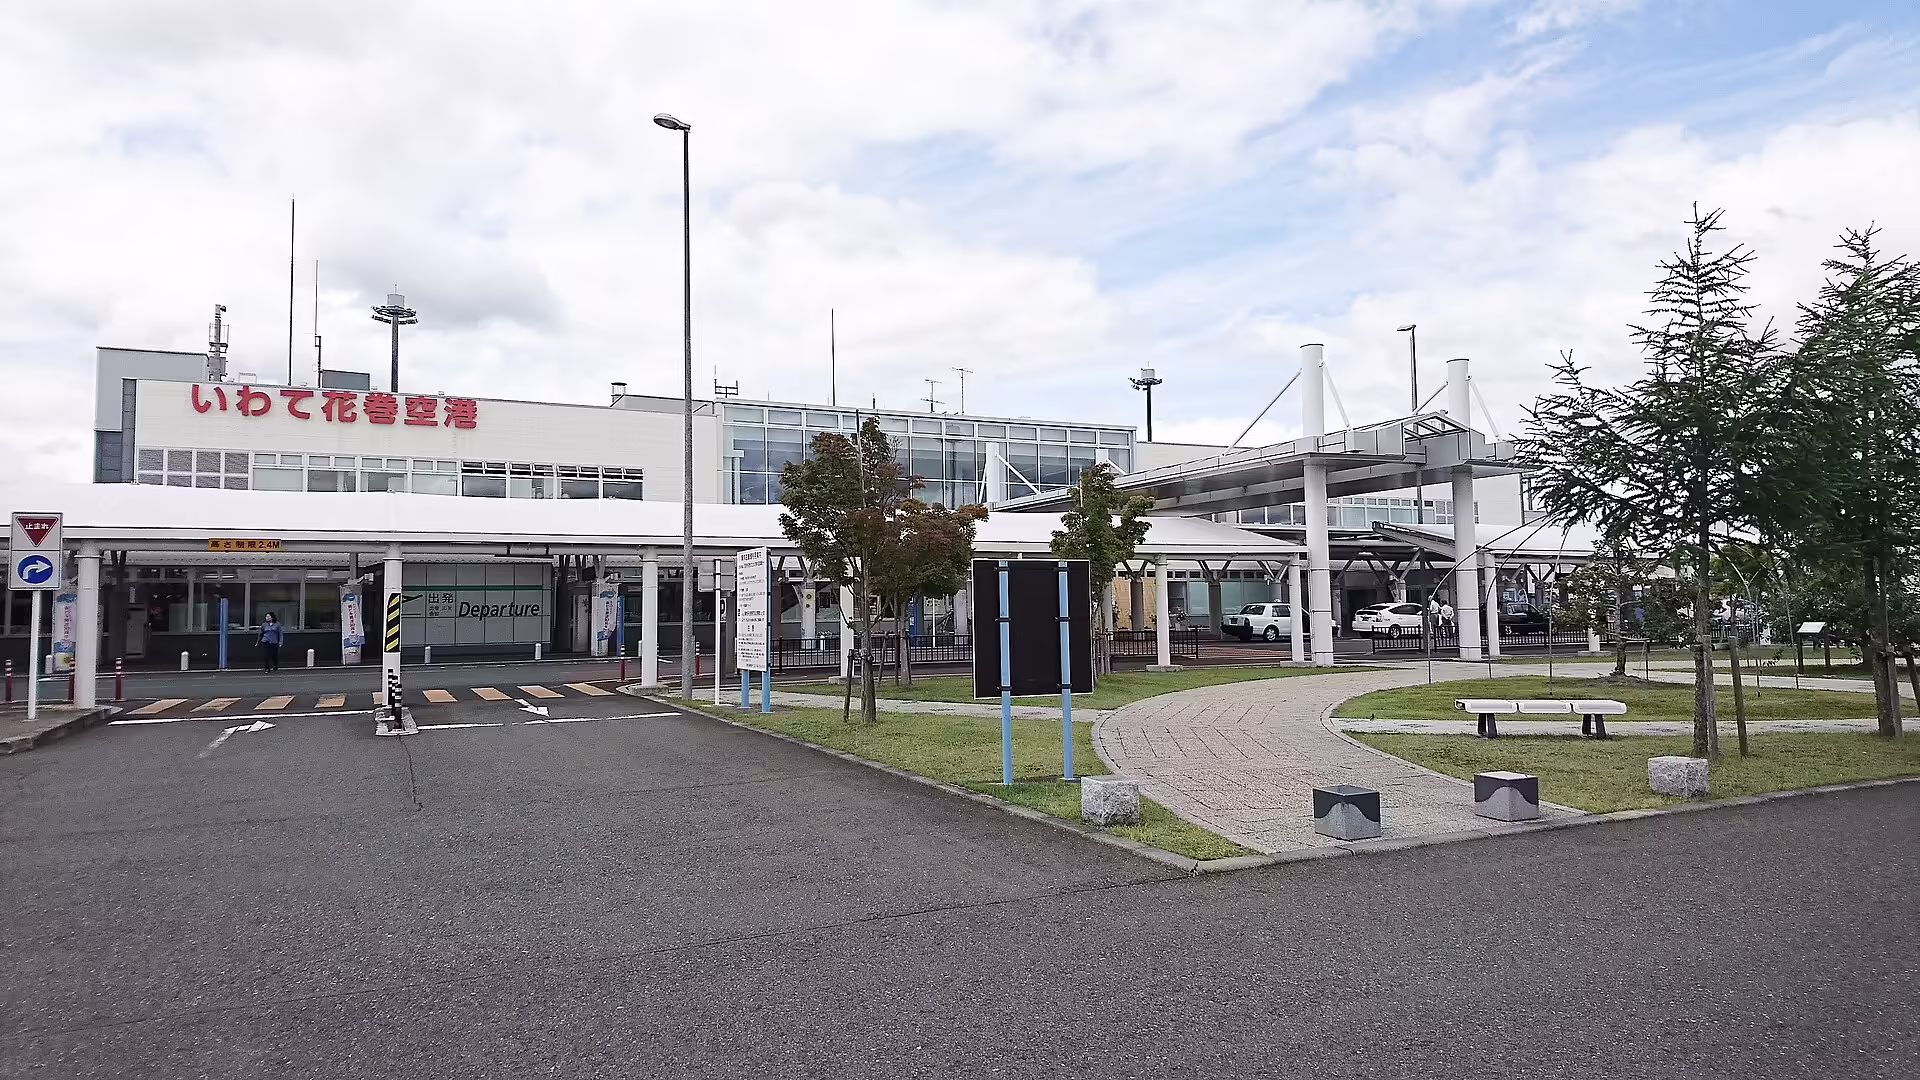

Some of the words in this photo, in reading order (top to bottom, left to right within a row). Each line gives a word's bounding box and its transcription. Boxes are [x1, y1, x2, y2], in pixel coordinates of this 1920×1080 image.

[191, 384, 477, 429] いわて花巻空港
[25, 522, 49, 530] 止まれ
[211, 541, 280, 549] 高さ制限2.4M
[428, 593, 454, 604] 出発
[459, 602, 540, 621] Departure
